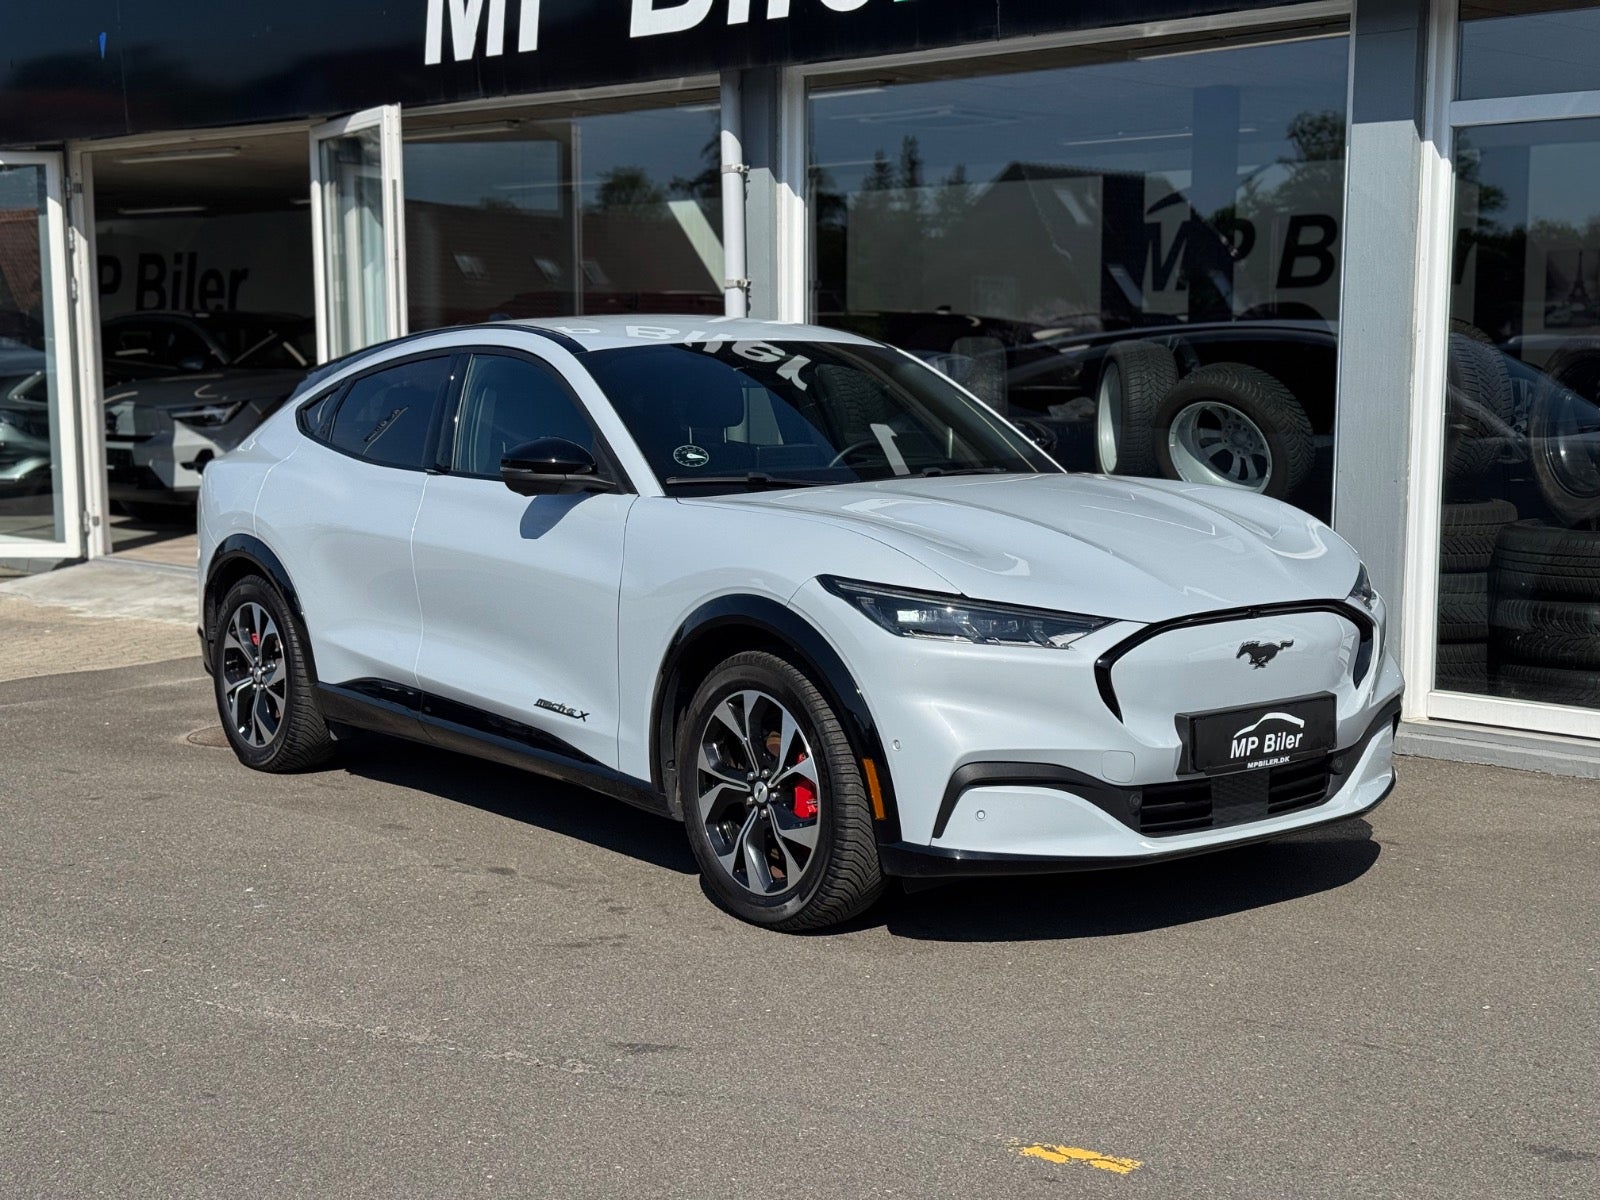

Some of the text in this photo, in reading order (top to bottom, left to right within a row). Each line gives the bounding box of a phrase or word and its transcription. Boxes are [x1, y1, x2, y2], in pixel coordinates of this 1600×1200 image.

[136, 251, 249, 311] Biler
[1230, 731, 1303, 759] MP Biler
[1247, 755, 1291, 769] MPBILER.DK
